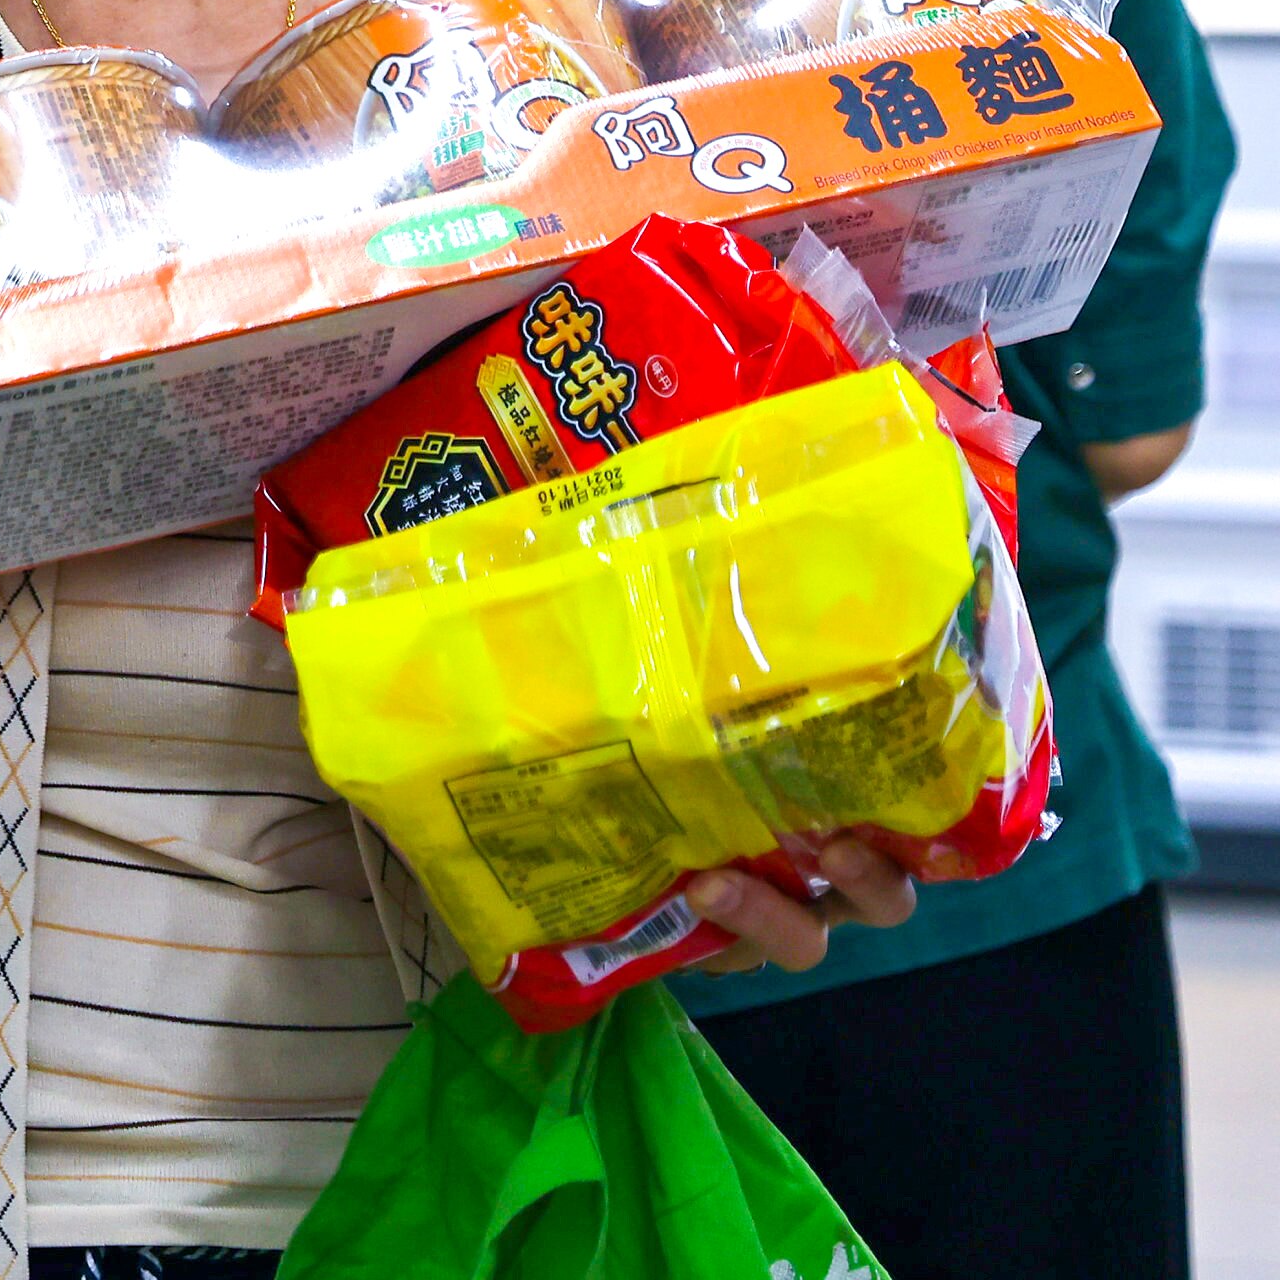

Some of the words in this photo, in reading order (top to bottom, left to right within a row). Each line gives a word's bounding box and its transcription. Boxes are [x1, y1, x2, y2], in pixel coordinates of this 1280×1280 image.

[593, 98, 794, 194] 阿Q
[830, 30, 1075, 152] 桶麵
[814, 168, 861, 188] Braised
[863, 163, 891, 178] Pork
[893, 154, 927, 171] Chop
[954, 137, 1003, 157] Chicken
[1005, 128, 1042, 146] Flavor
[1044, 121, 1085, 137] Instant
[1087, 108, 1136, 128] Noodles
[537, 466, 623, 504] 2021.11.10
